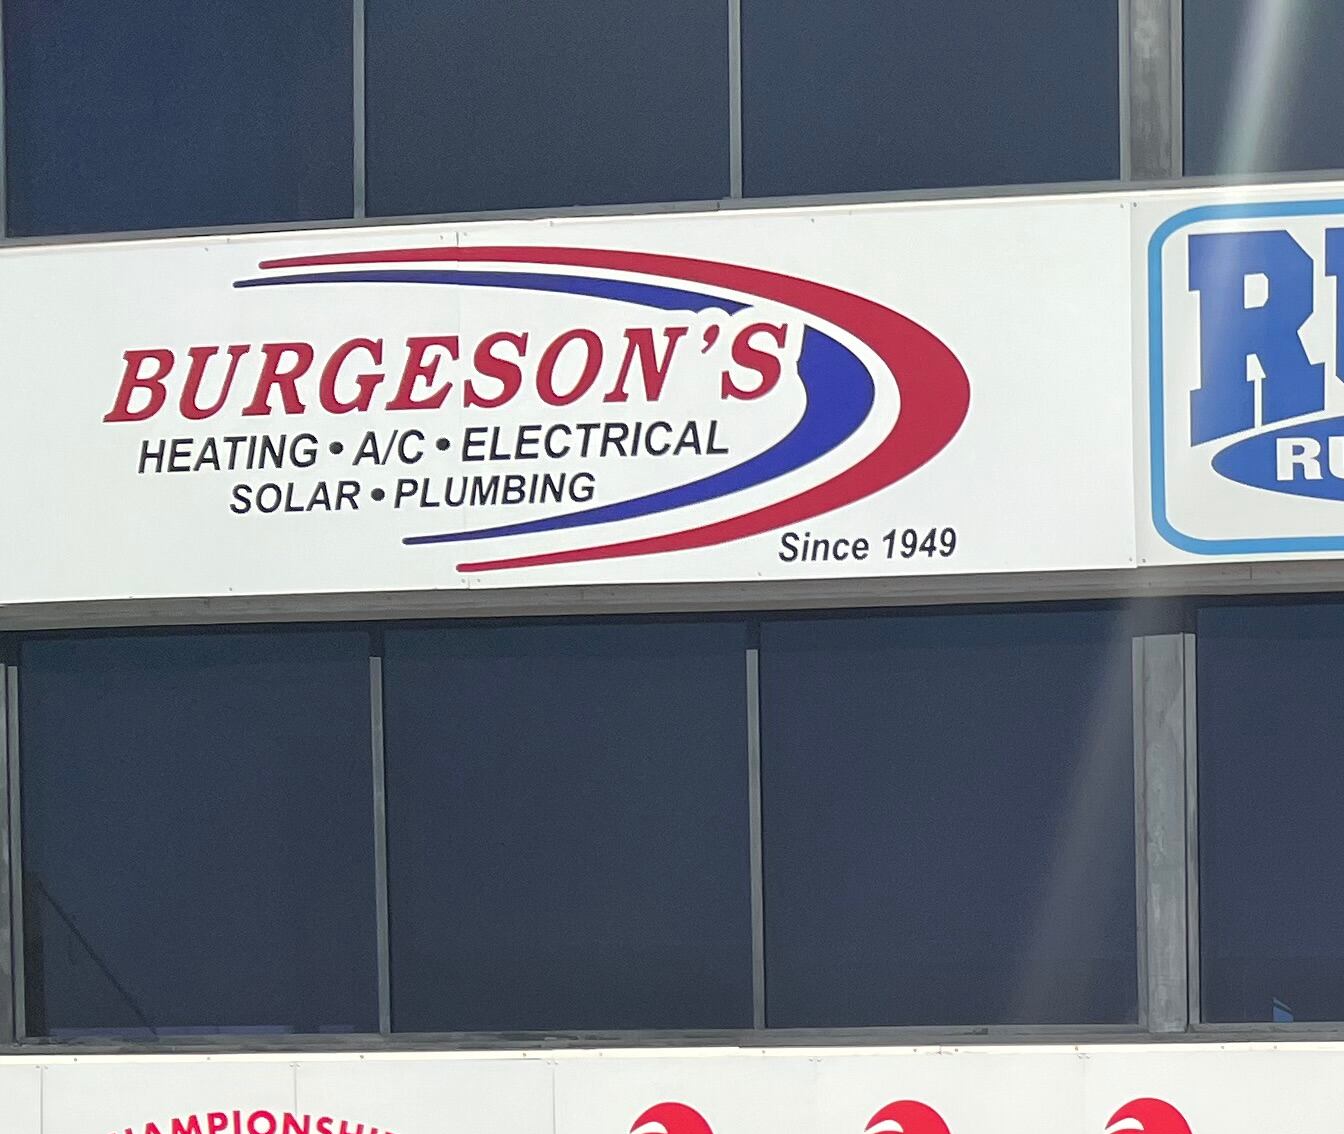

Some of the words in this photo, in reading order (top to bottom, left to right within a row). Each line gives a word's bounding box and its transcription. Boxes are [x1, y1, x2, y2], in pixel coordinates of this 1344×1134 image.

[103, 323, 787, 424] BURGESON'S
[138, 433, 319, 474] HEATING
[353, 429, 425, 466] A/C
[462, 420, 729, 462] ELECTRICAL
[230, 480, 361, 515] SOLAR
[394, 472, 596, 509] PLUMBING
[778, 531, 870, 562] Since
[882, 527, 957, 559] 1949
